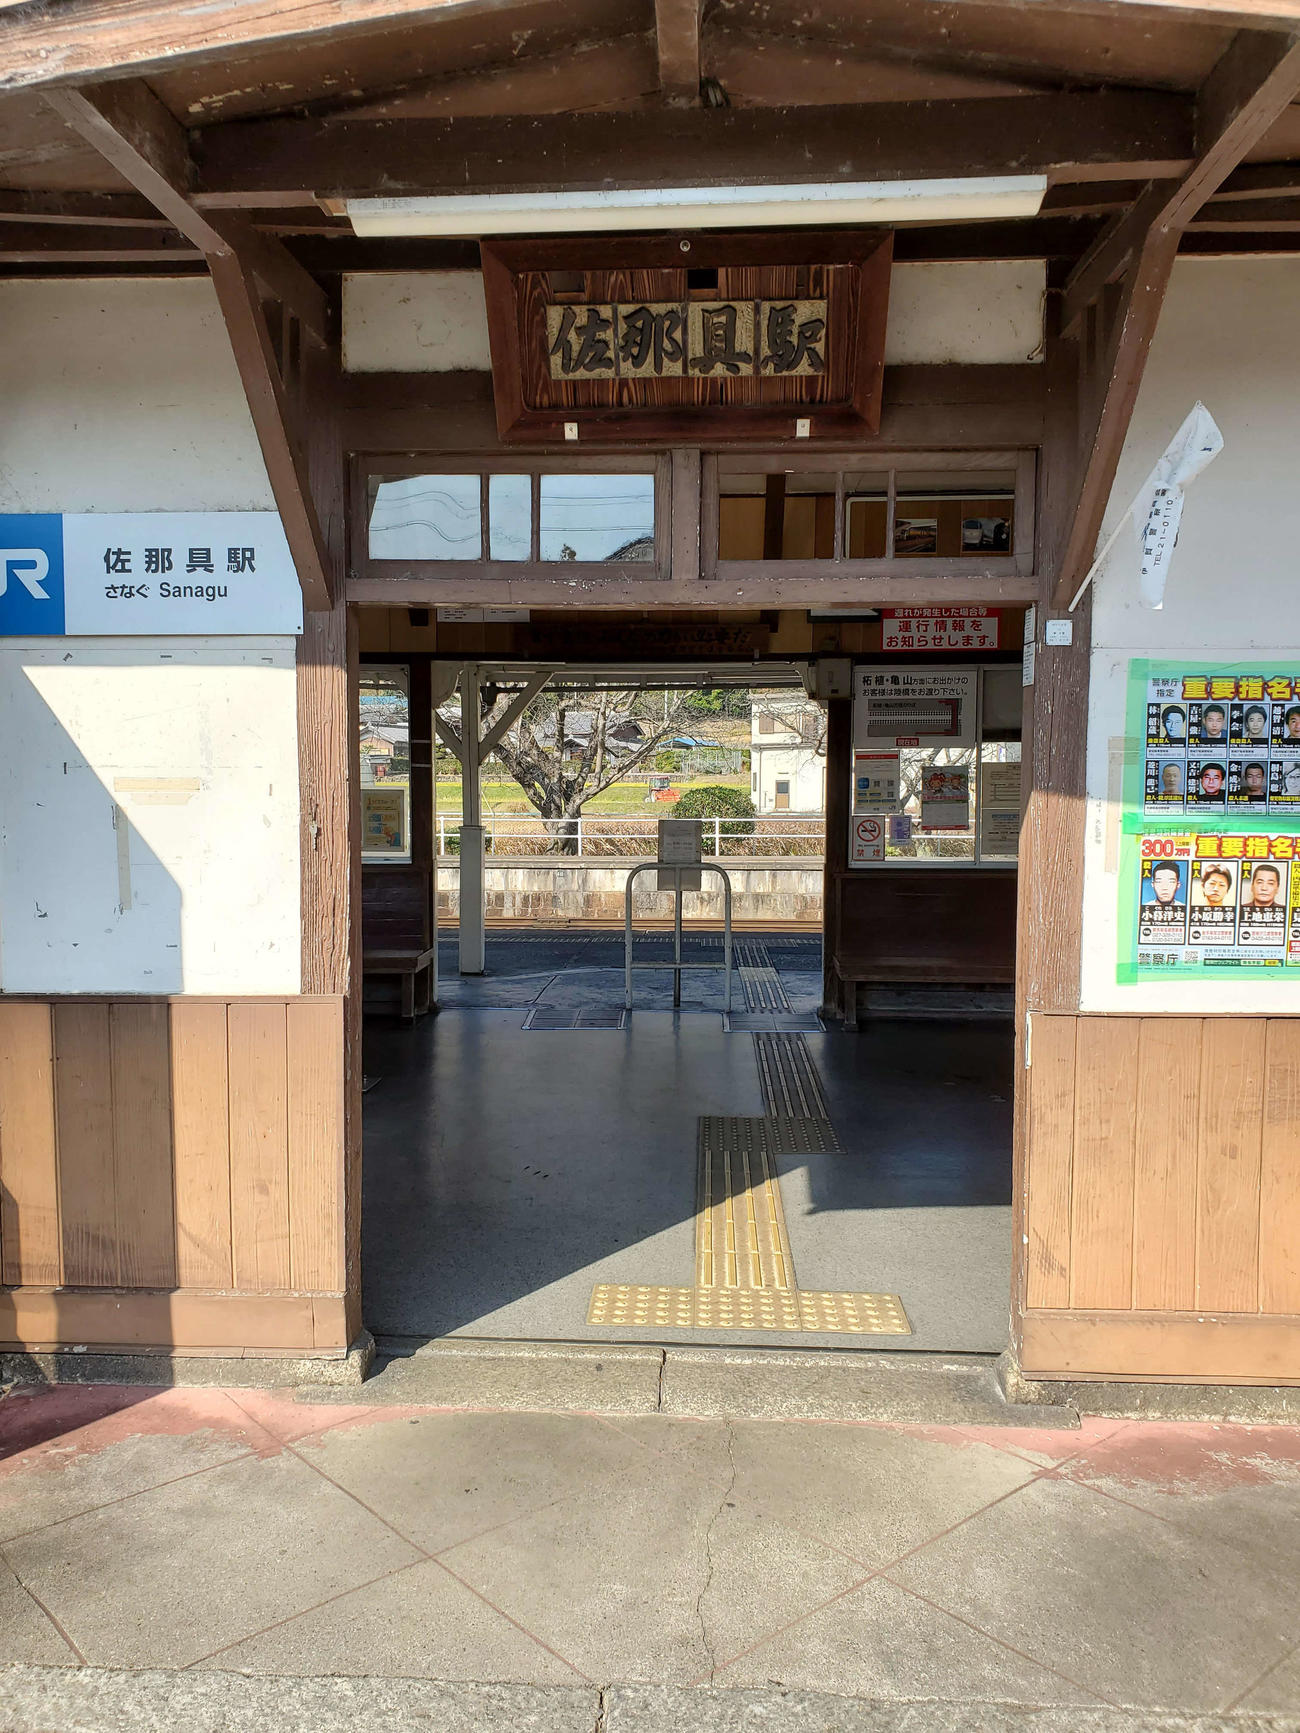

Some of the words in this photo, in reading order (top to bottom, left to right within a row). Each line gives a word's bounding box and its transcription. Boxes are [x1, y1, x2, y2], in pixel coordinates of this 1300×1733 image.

[103, 547, 257, 574] 佐那具駅
[104, 583, 151, 599] さなぐ
[159, 582, 228, 601] Sanagu
[898, 619, 983, 633] 運行情報を
[886, 634, 995, 648] お知らせします。
[1156, 688, 1175, 698] 指定
[1141, 839, 1174, 857] 300
[1138, 953, 1179, 966] 警察庁
